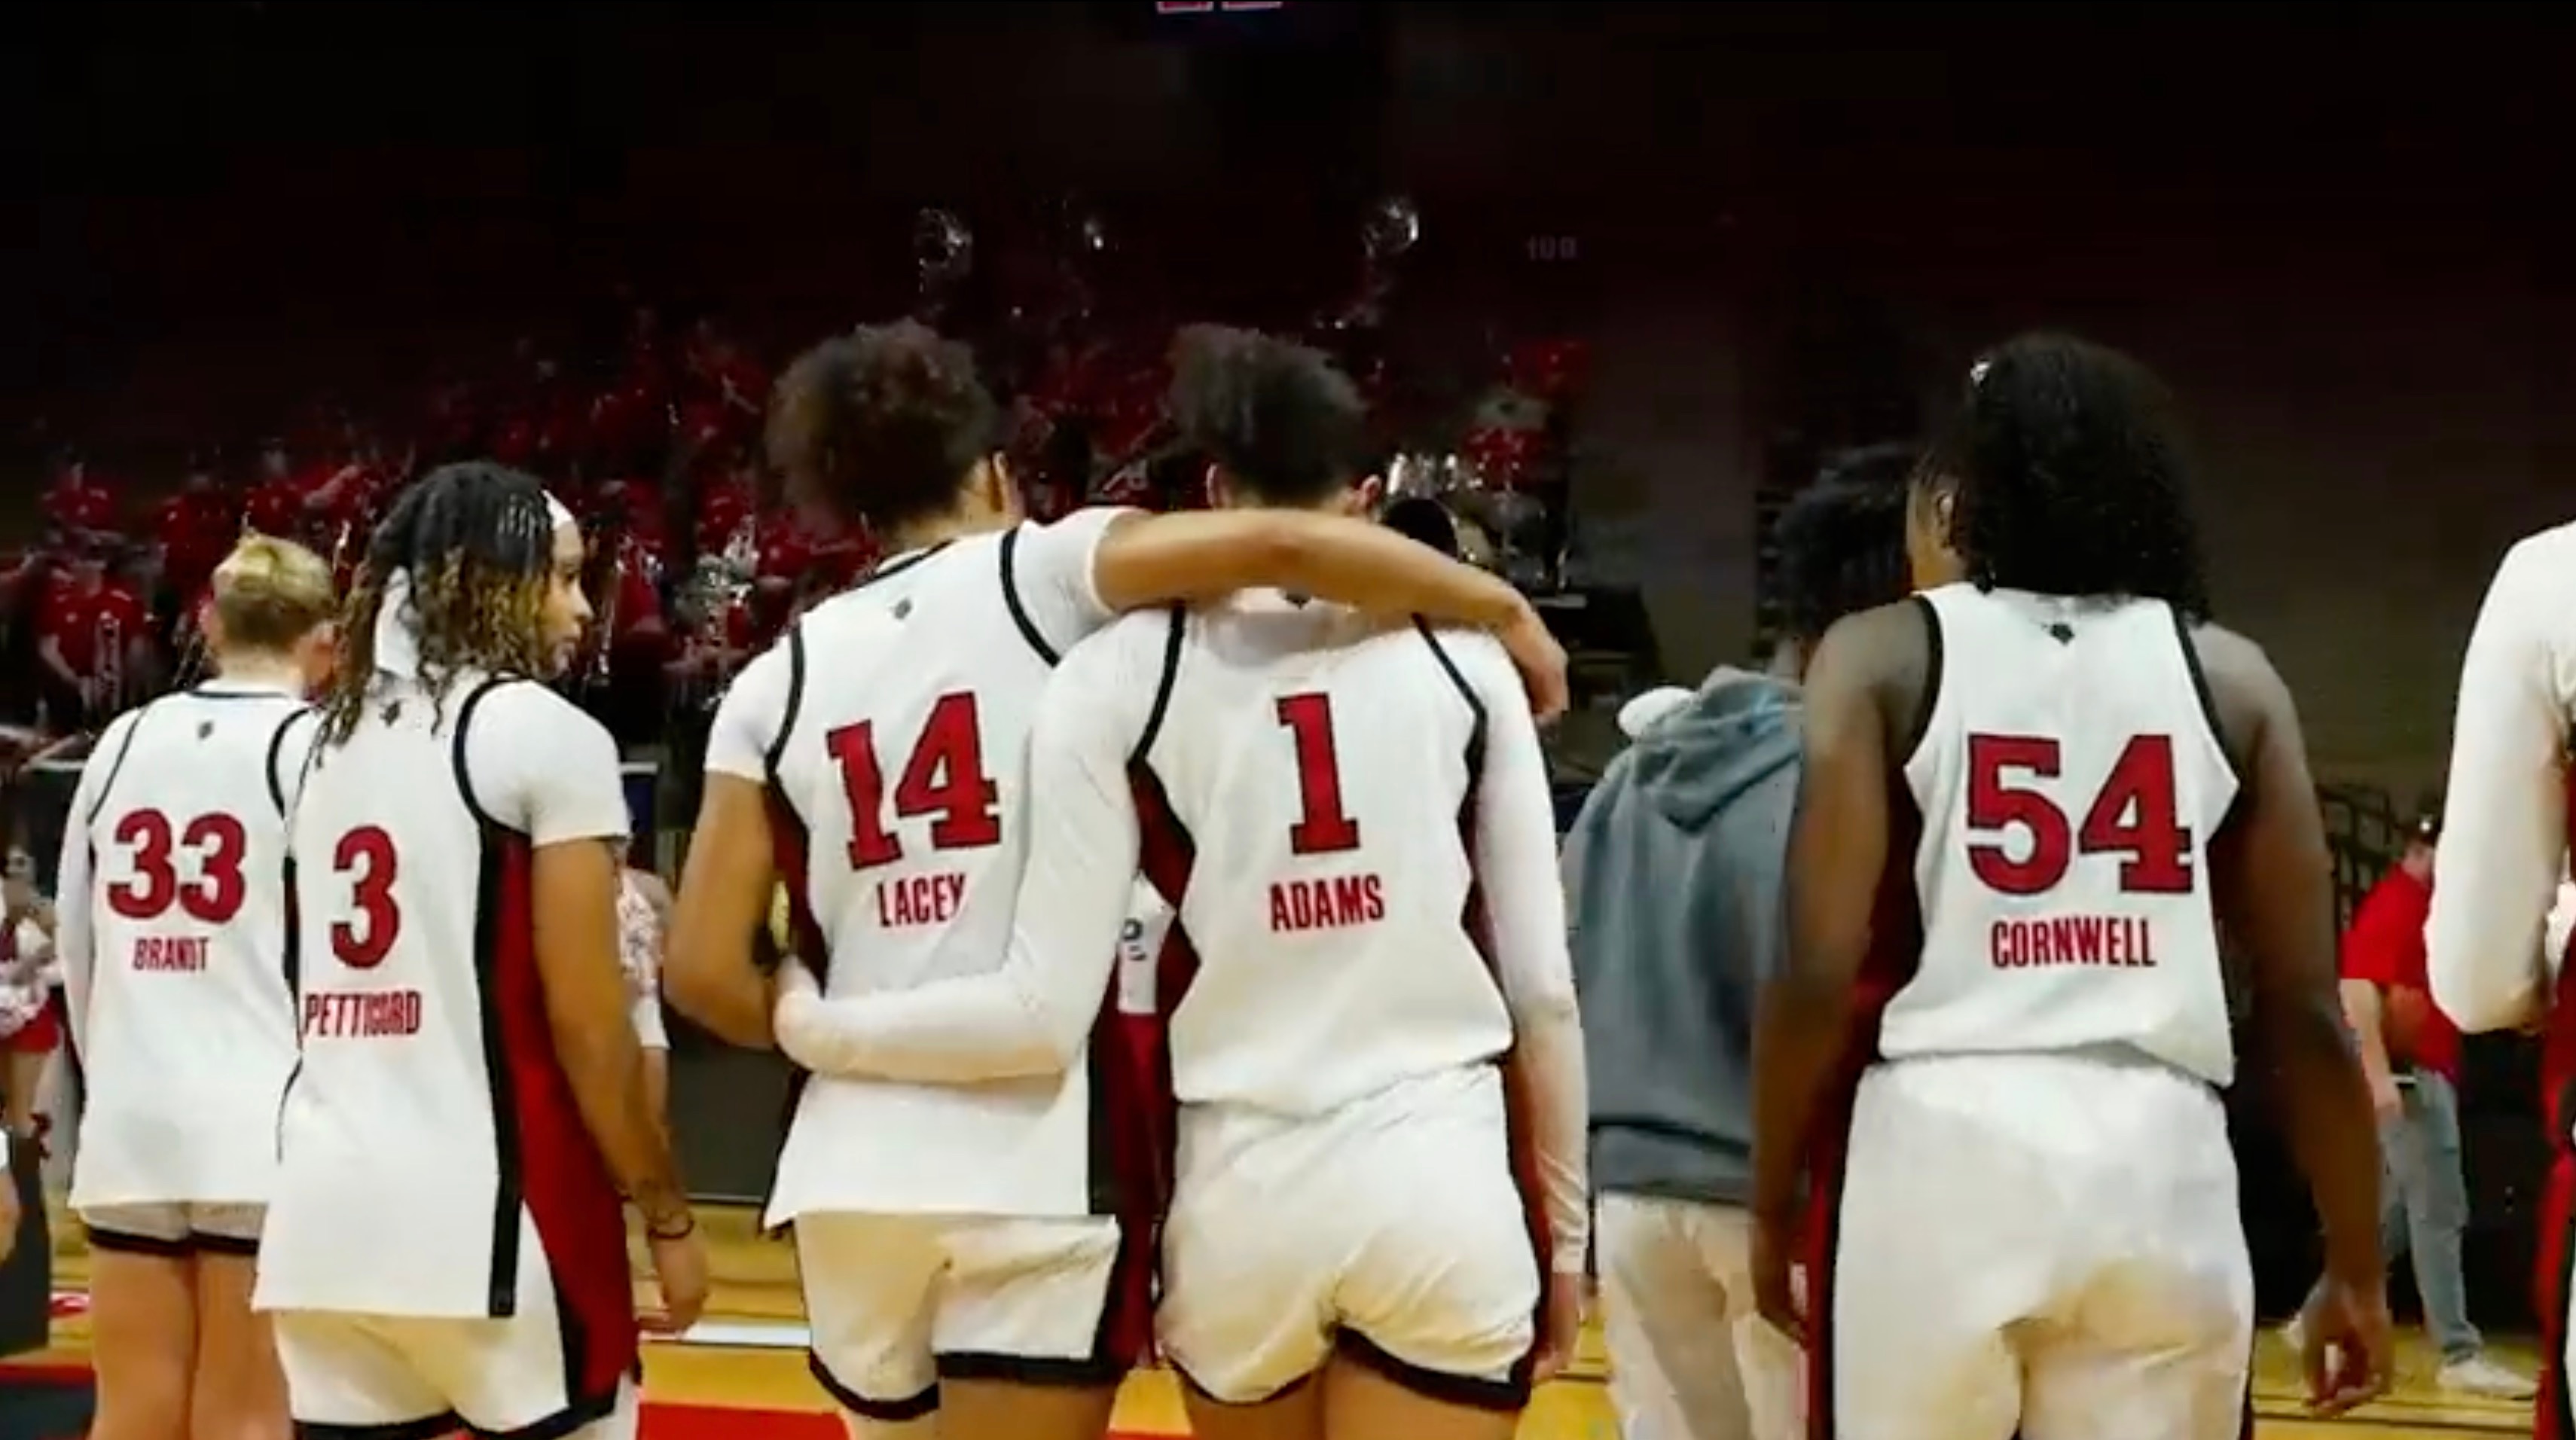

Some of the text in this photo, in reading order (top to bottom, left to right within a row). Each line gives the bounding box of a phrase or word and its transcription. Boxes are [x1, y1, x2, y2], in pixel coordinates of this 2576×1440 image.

[826, 691, 1001, 871] 14
[1276, 692, 1360, 856] 1
[1967, 733, 2194, 896] 54
[108, 808, 246, 924] 33
[331, 825, 400, 969] 3
[877, 873, 966, 927] LACEY
[1270, 874, 1384, 932] ADAMS
[1991, 917, 2156, 969] CORNWELL
